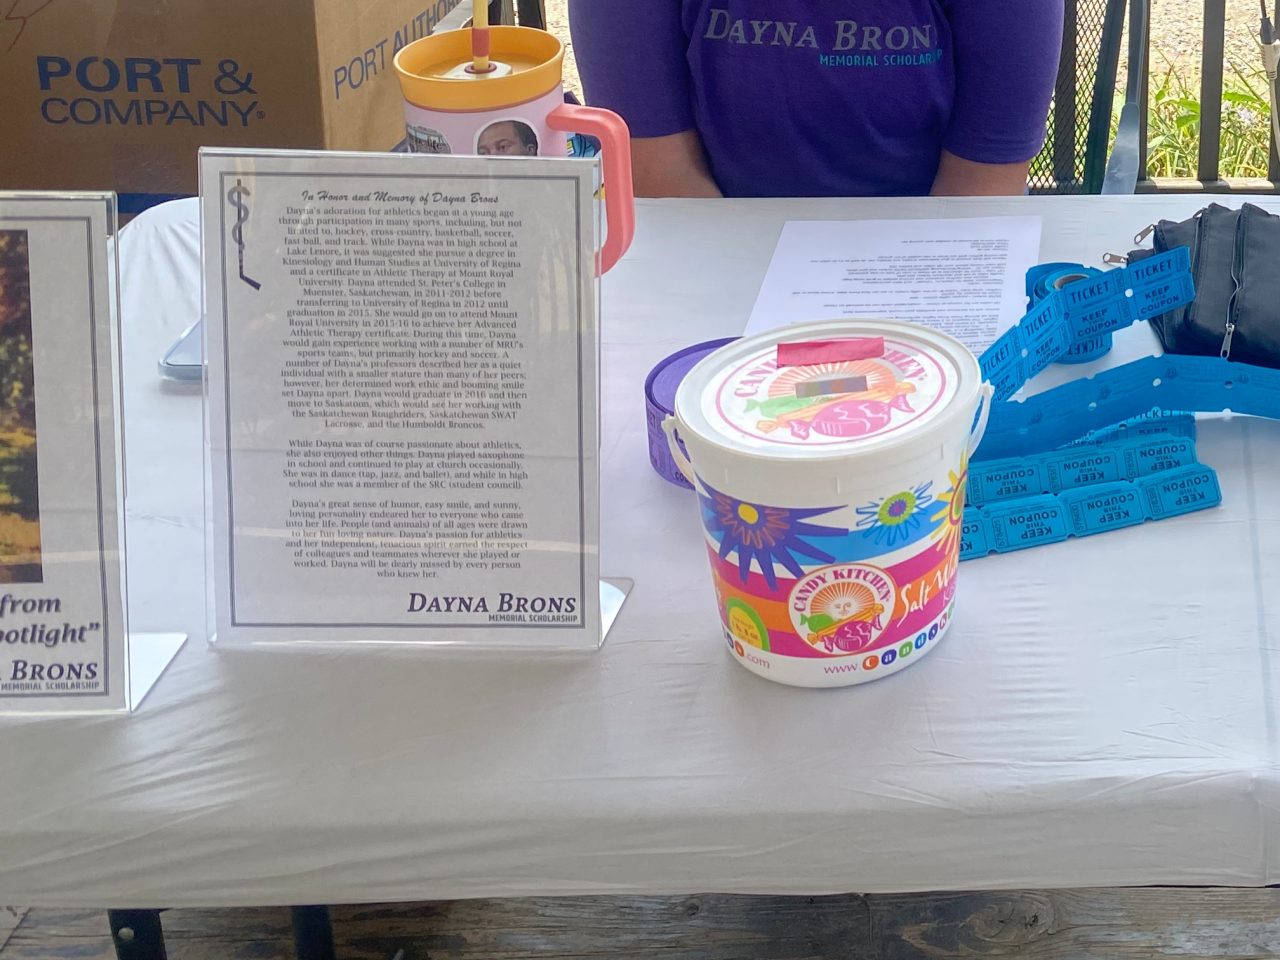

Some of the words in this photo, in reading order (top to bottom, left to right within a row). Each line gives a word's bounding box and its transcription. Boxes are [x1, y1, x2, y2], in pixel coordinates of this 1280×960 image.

[832, 20, 938, 51] BRON
[820, 54, 879, 67] MEMORIAL
[37, 56, 201, 93] PORT
[214, 59, 258, 95] &
[334, 39, 388, 100] PORT
[302, 190, 314, 200] In
[317, 191, 348, 201] Honor
[352, 192, 371, 201] and
[374, 191, 415, 205] Memory
[420, 192, 429, 205] of
[432, 192, 465, 205] Dayna
[471, 192, 498, 203] Brons
[1135, 259, 1172, 280] TICKET
[1071, 281, 1110, 304] TICKET
[1145, 285, 1170, 300] KEEP
[1140, 295, 1179, 314] COUPON
[1025, 308, 1052, 337] TICKET
[1082, 308, 1108, 323] KEEP
[1078, 318, 1118, 338] COUPON
[1035, 338, 1054, 355] KEEP
[982, 344, 1009, 375] TICKET
[1032, 347, 1060, 371] COUPON
[1140, 444, 1187, 458] COUPON
[1064, 456, 1111, 471] COUPON
[1151, 460, 1181, 471] KEEP
[986, 469, 1034, 482] COUPON
[1074, 472, 1105, 483] KEEP
[996, 484, 1027, 496] KEEP
[1163, 475, 1209, 493] COUPON
[292, 500, 325, 508] Dayna's
[328, 501, 349, 509] great
[380, 500, 388, 508] of
[391, 500, 422, 509] humor,
[425, 502, 444, 510] easy
[446, 501, 471, 509] smile,
[1087, 493, 1135, 510] COUPON
[1175, 492, 1205, 506] KEEP
[1010, 510, 1058, 526] COUPON
[1100, 510, 1130, 523] KEEP
[1021, 527, 1053, 540] KEEP
[331, 560, 358, 568] Dayna
[391, 560, 417, 569] dearly
[420, 560, 450, 568] missed
[453, 560, 463, 569] by
[492, 562, 520, 570] person
[377, 569, 395, 577] who
[398, 570, 418, 578] knew
[423, 570, 438, 578] her.
[794, 573, 827, 612] CANDY
[832, 569, 890, 600] KITCHEN
[0, 593, 61, 619] from
[896, 580, 932, 628] Salt
[489, 614, 526, 622] MEMORIAL
[529, 614, 577, 622] SCHOLARSHIP
[0, 622, 100, 648] otlight"
[1, 681, 42, 691] MEMORIAL
[45, 681, 99, 690] SCHOLARSHIP
